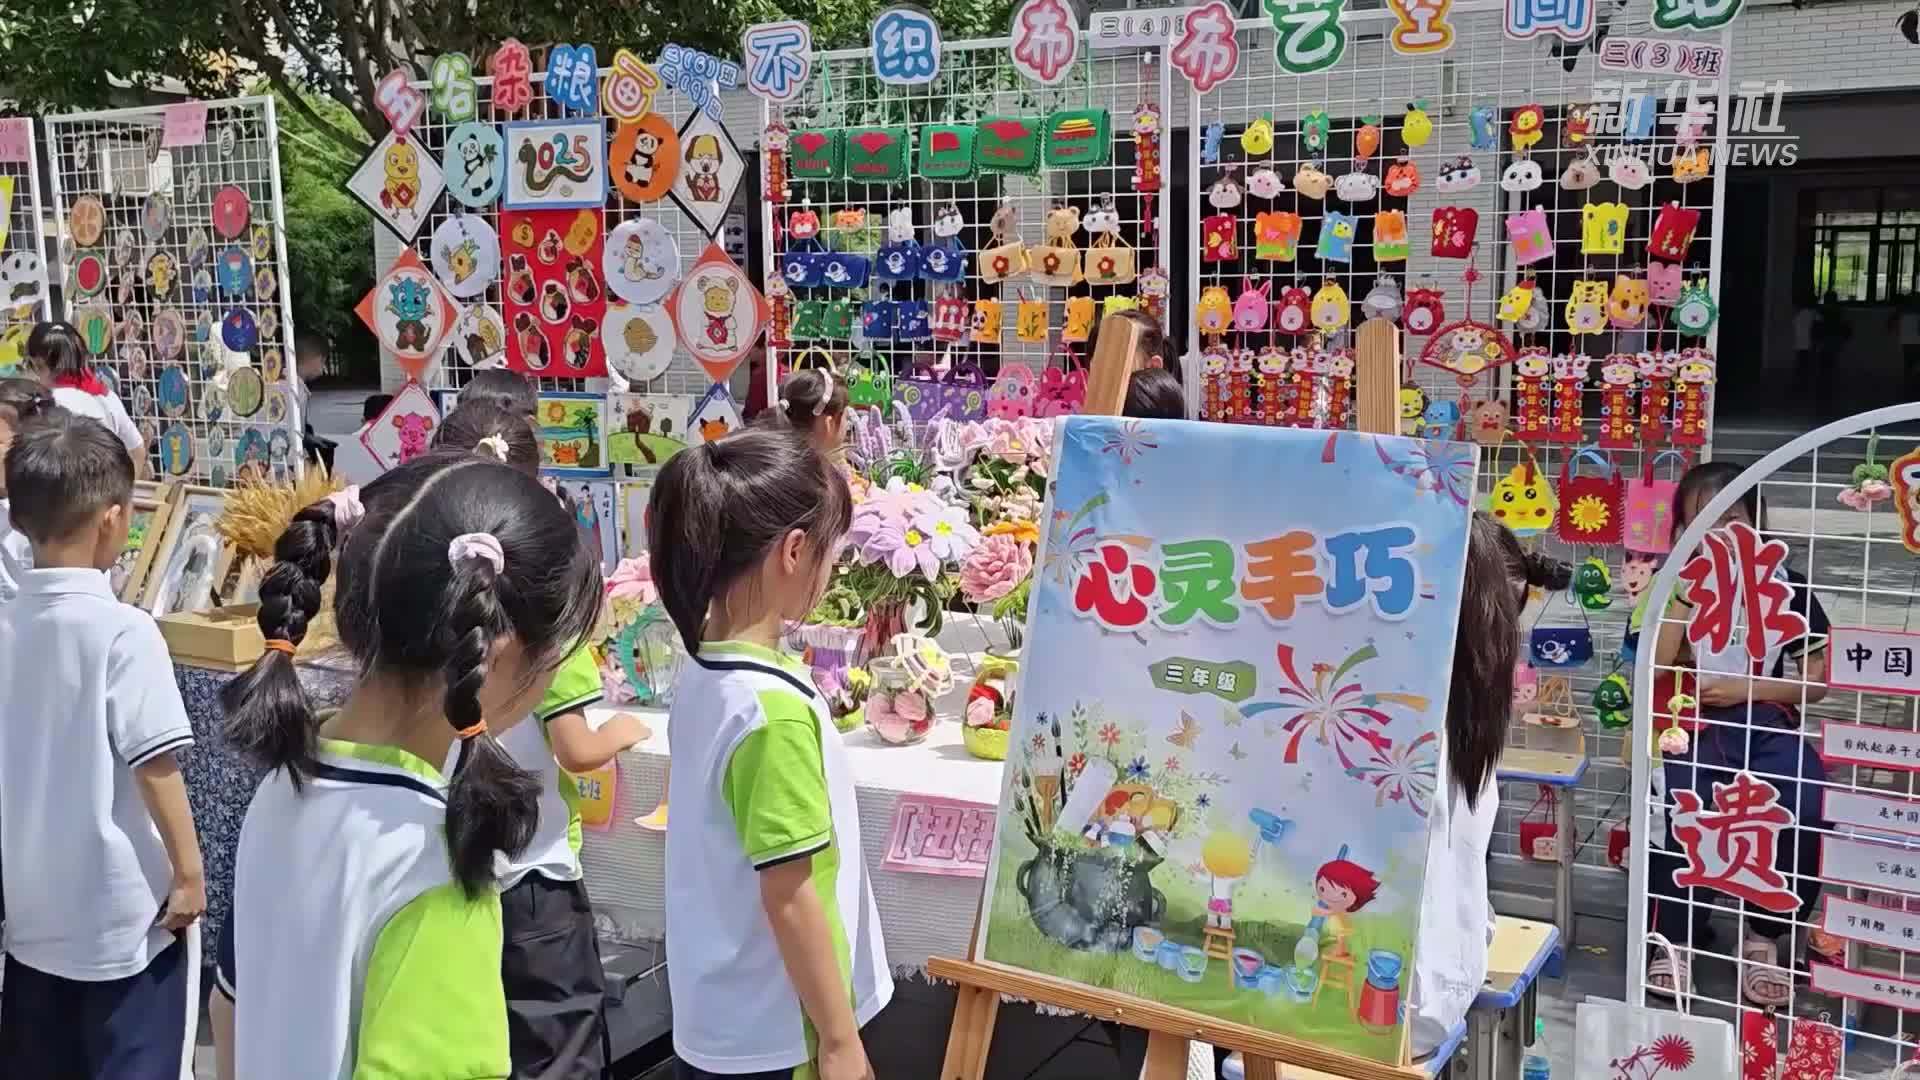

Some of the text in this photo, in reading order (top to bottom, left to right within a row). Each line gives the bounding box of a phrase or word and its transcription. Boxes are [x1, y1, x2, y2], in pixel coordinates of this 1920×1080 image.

[748, 4, 1075, 94] 不织布
[1602, 40, 1724, 77] 三(3)班
[1074, 527, 1418, 627] 心灵手巧
[1165, 663, 1237, 692] 三年级
[1846, 642, 1912, 677] 中国
